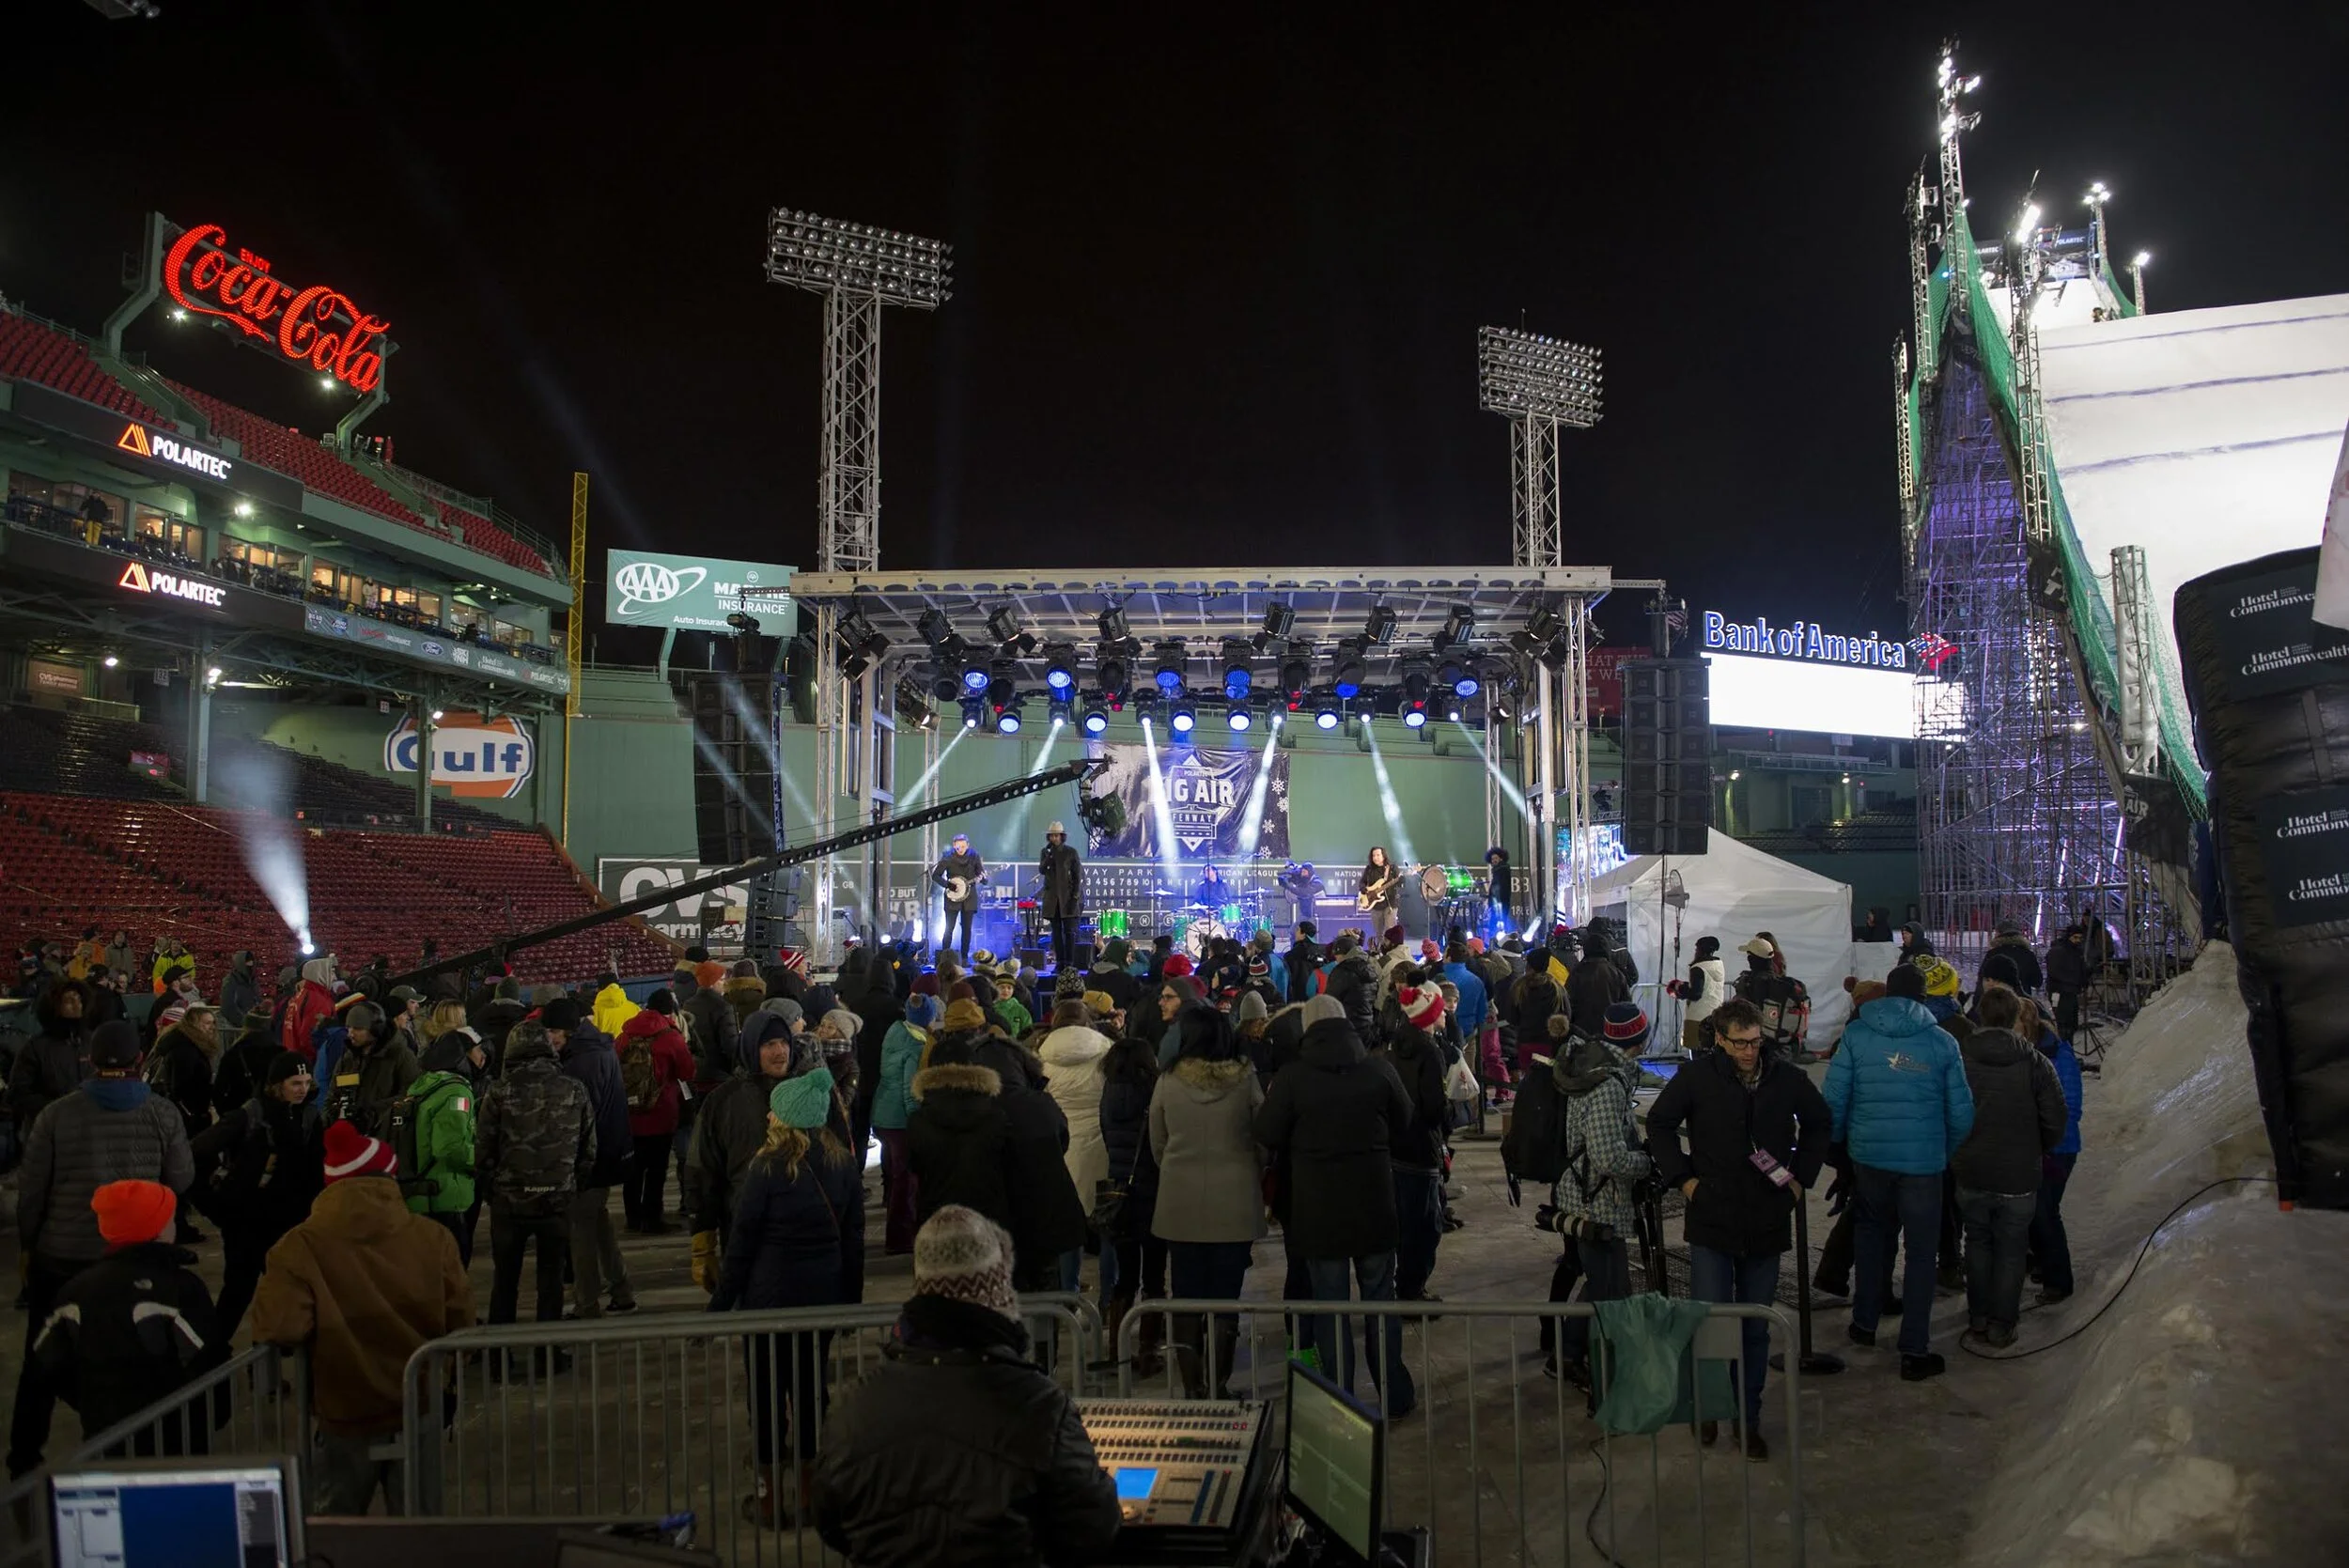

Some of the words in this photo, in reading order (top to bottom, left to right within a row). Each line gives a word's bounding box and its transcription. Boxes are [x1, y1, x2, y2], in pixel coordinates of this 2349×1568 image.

[240, 247, 272, 274] ENJOY
[164, 224, 391, 392] Coca-Cola
[152, 435, 232, 480] POLARTEC
[151, 571, 226, 607] POLARTEC
[623, 564, 672, 602] AAA
[718, 599, 788, 615] INSURANCE
[2240, 589, 2279, 608] Hotel
[673, 615, 694, 625] Auto
[696, 616, 730, 627] Insuran
[1703, 610, 1775, 655] Bank
[1777, 620, 1804, 658] of
[1806, 623, 1907, 669] America
[2241, 644, 2349, 676] Commonwealth
[2251, 645, 2290, 665] Hotel
[396, 735, 524, 773] Gulf
[1194, 779, 1235, 805] AIR
[2125, 799, 2150, 817] AIR
[1172, 813, 1212, 823] FENWAY
[2288, 811, 2328, 828] Hotel
[842, 880, 854, 889] GB
[2299, 873, 2341, 891] Hotel
[897, 888, 917, 898] BUT
[1085, 888, 1139, 896] OLARTEC
[523, 1186, 556, 1194] Kappa
